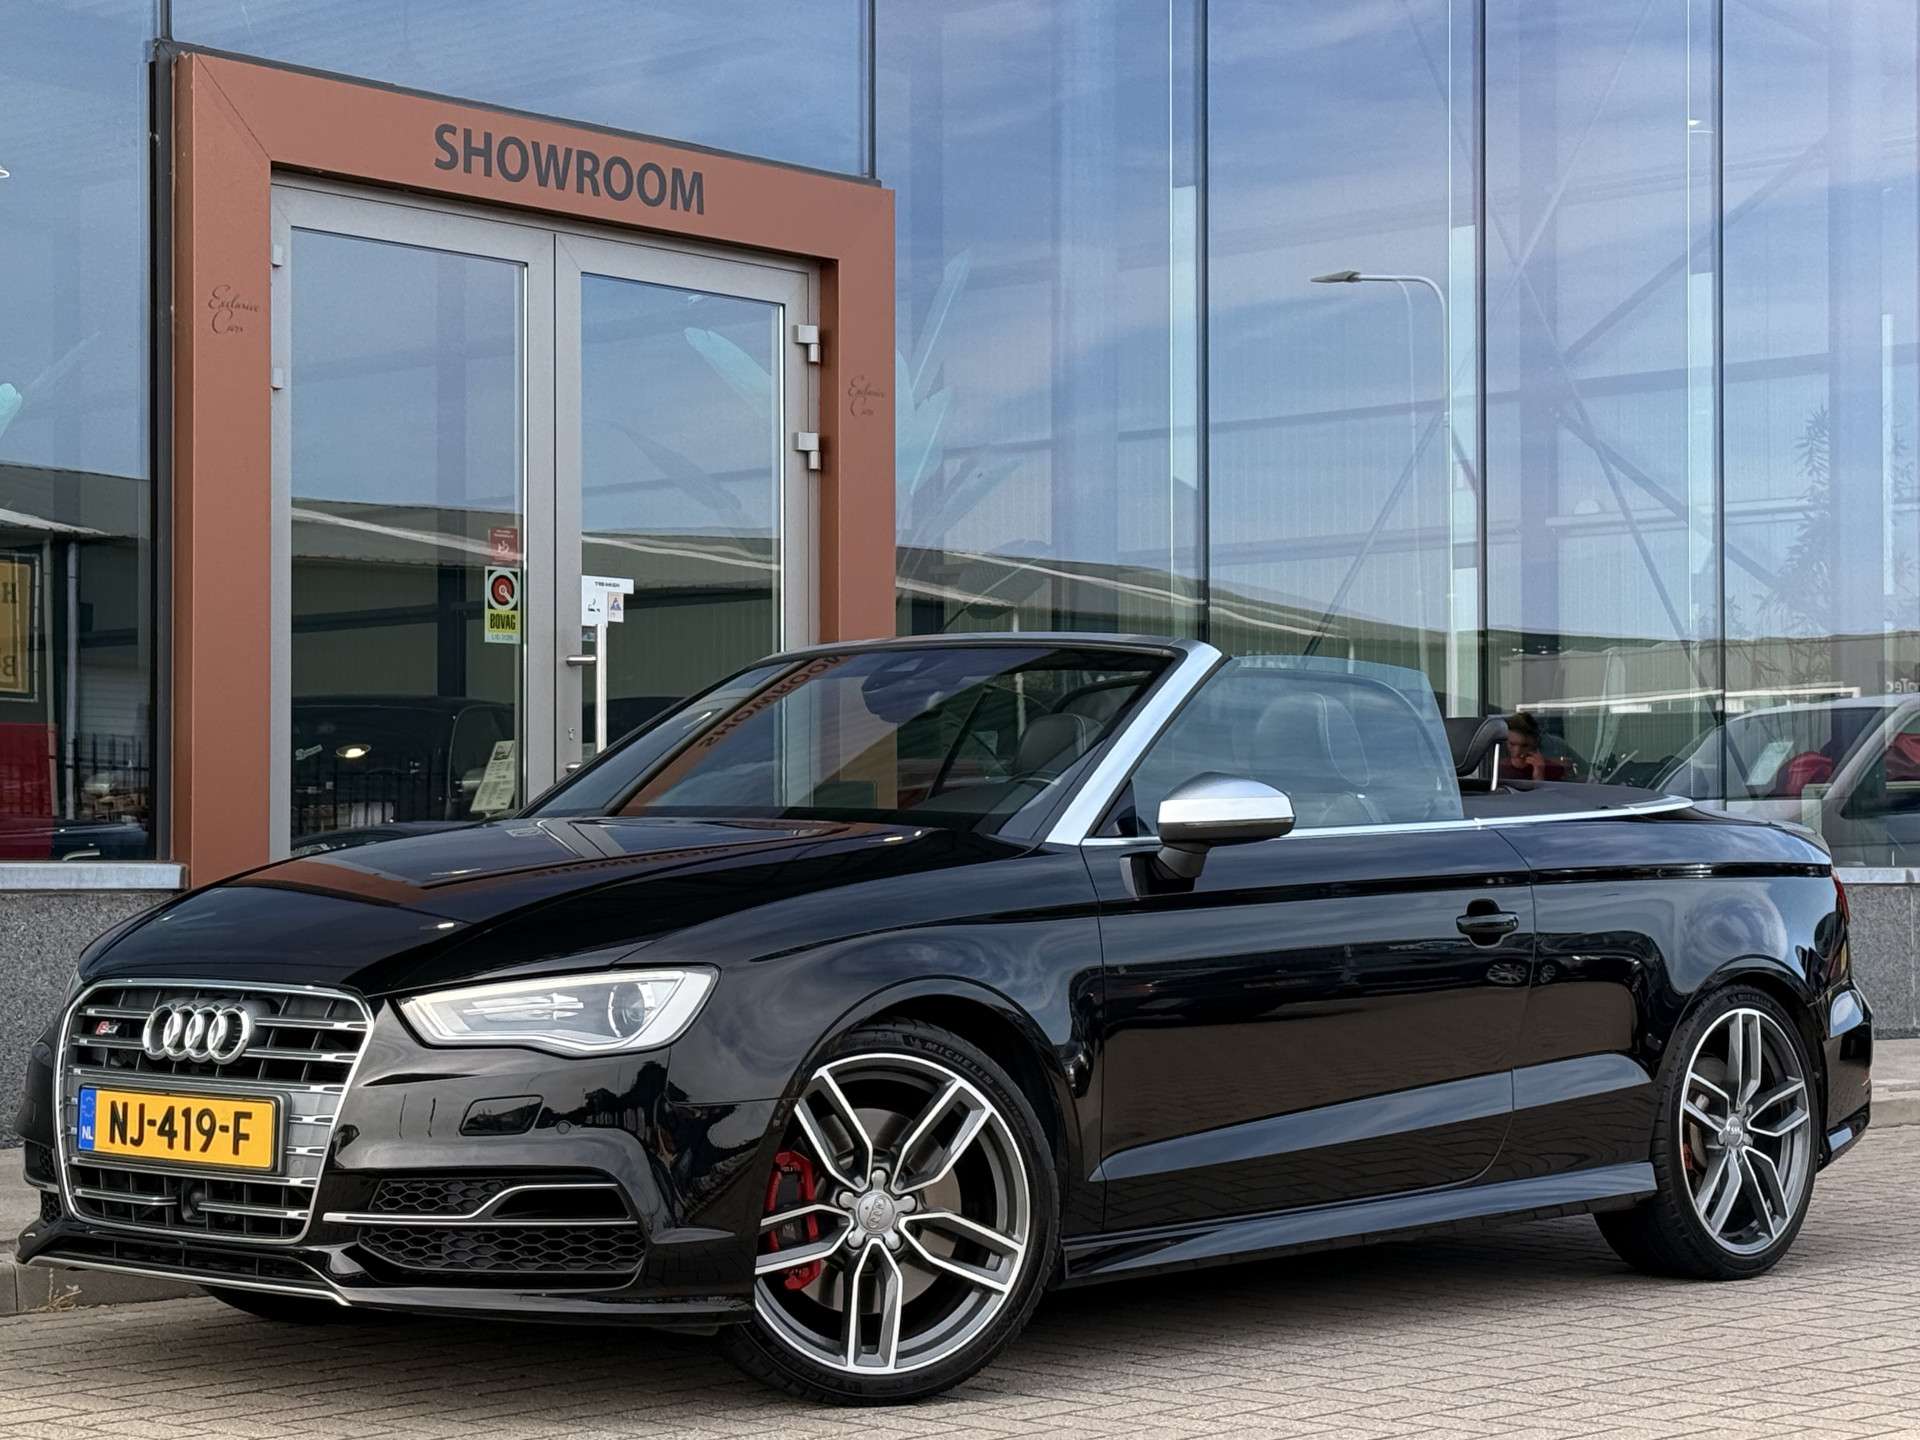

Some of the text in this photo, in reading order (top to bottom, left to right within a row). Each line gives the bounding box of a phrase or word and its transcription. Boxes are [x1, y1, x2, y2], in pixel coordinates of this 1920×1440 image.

[434, 123, 705, 215] SHOWROOM
[490, 613, 516, 630] BOVAG
[923, 1040, 996, 1087] MICHELIN
[81, 1125, 94, 1141] NL
[108, 1099, 253, 1156] NJ-419-F
